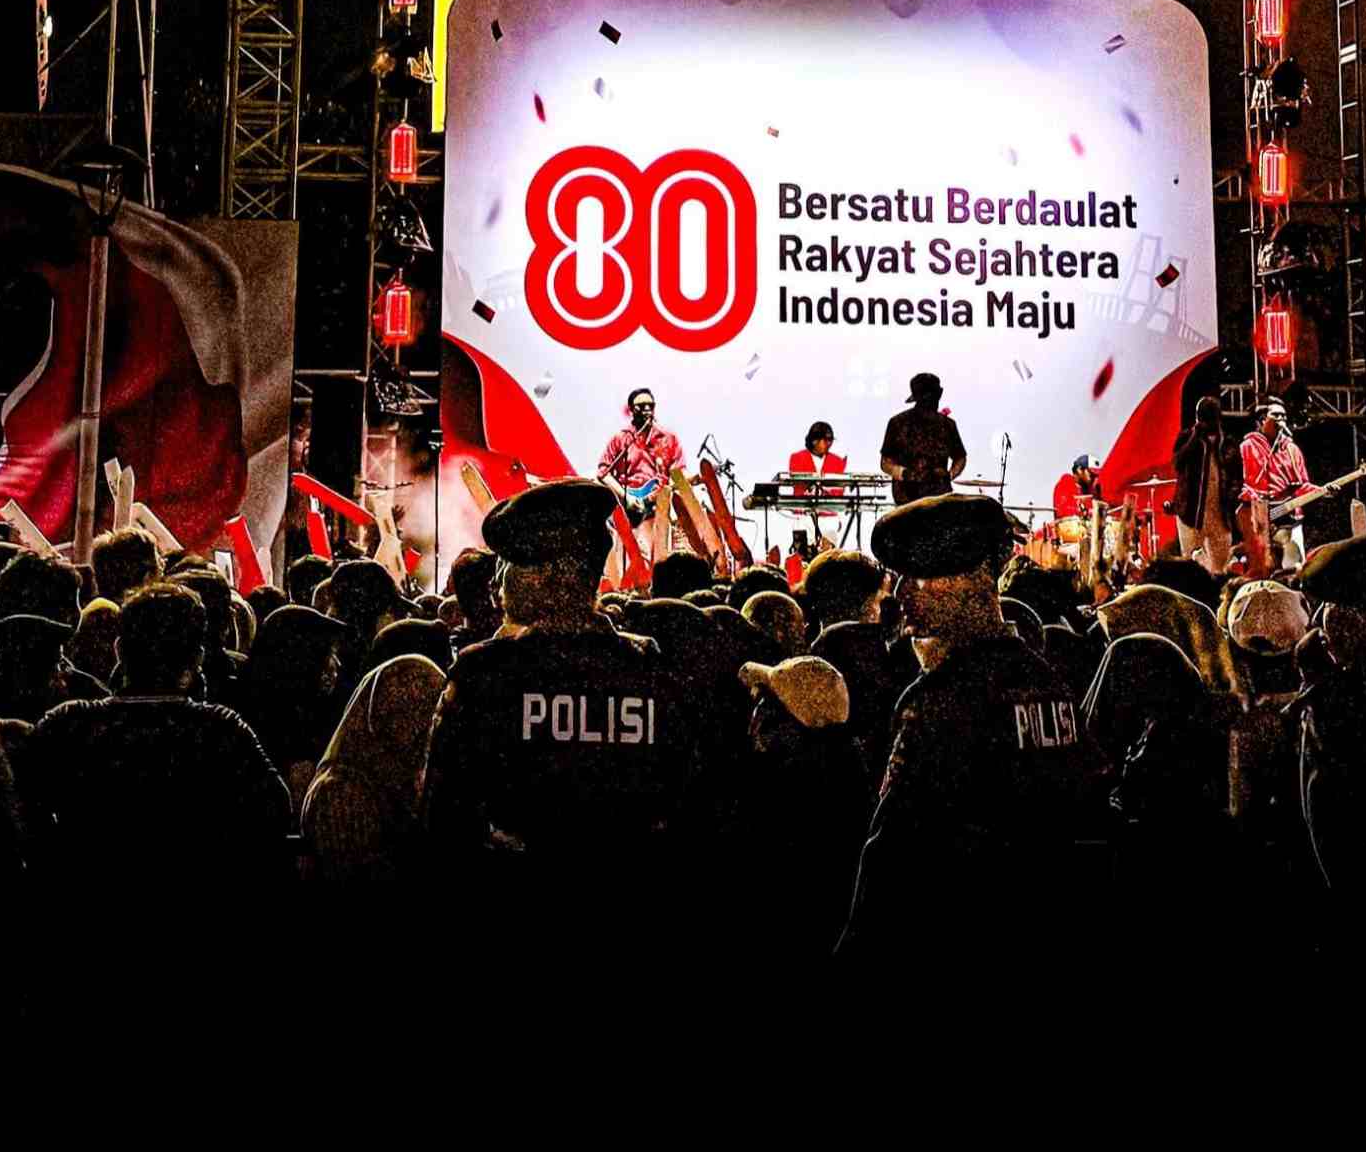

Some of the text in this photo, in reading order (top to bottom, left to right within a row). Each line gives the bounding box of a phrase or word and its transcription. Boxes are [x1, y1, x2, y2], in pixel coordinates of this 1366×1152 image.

[778, 182, 1138, 229] Bersatu Berdaulat
[524, 145, 757, 352] 80
[778, 234, 1120, 285] Rakyat Sejahtera
[778, 286, 1076, 339] Indonesia Maju
[522, 691, 656, 745] POLISI
[1015, 701, 1079, 749] POLISI
